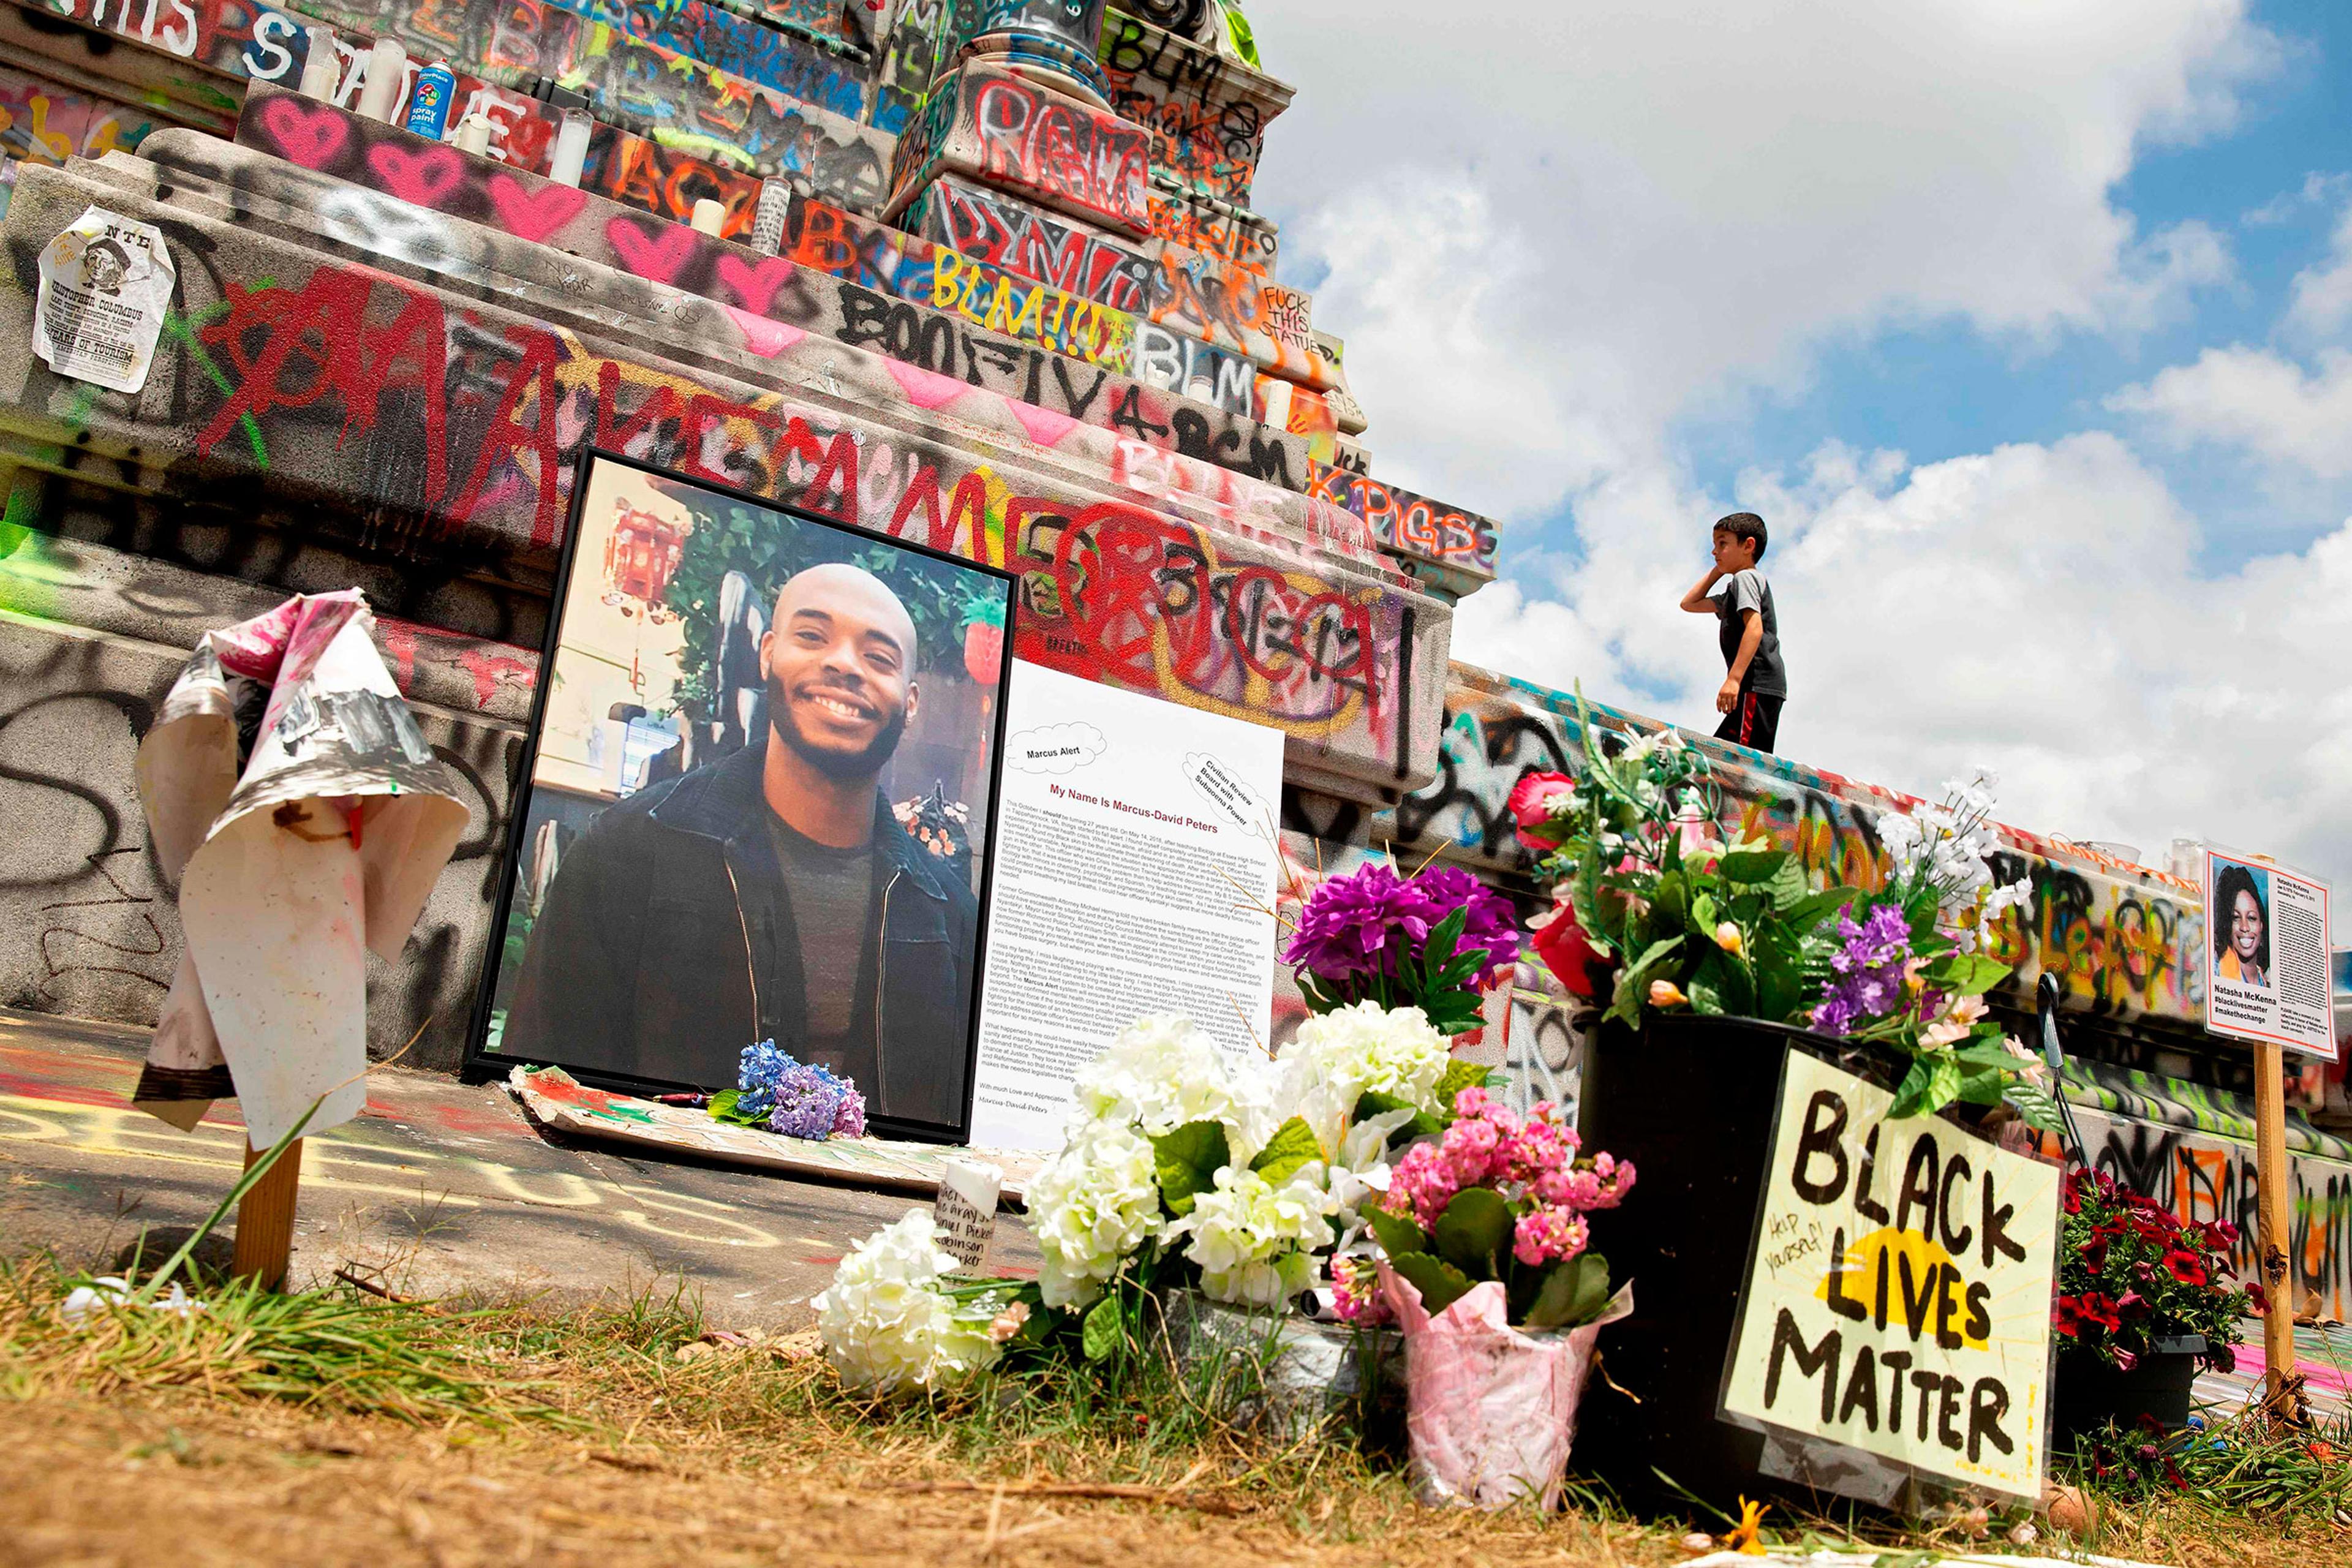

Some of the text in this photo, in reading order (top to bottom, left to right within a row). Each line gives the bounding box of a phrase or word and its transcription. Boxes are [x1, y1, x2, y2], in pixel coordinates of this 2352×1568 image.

[1108, 18, 1222, 110] BLM
[410, 115, 434, 124] paint
[412, 107, 437, 118] spray
[104, 224, 151, 249] NTE
[98, 299, 143, 322] COLUMBUS
[1264, 286, 1309, 314] FUCK
[1268, 309, 1308, 333] THIS
[78, 337, 92, 350] OF
[94, 341, 133, 363] TOURISM
[1259, 320, 1321, 355] STATUE
[1349, 477, 1479, 557] PIGS
[1027, 746, 1080, 759] Marcus Alert
[1200, 767, 1234, 801] Board with
[1205, 760, 1253, 807] Civilian Review
[1049, 783, 1218, 834] My Name Is Marcus-David Peters
[1195, 774, 1248, 826] Subpoena Power
[1042, 809, 1061, 818] should
[1023, 977, 1043, 986] Marcus
[2214, 984, 2277, 1005] Natasha McKenna
[2215, 996, 2268, 1013] #blacklivesmatter
[2215, 1006, 2266, 1024] #makethechange
[1792, 1089, 2026, 1269] BLACK
[1828, 1226, 1991, 1350] LIVES
[1764, 1307, 2014, 1463] MATTER
